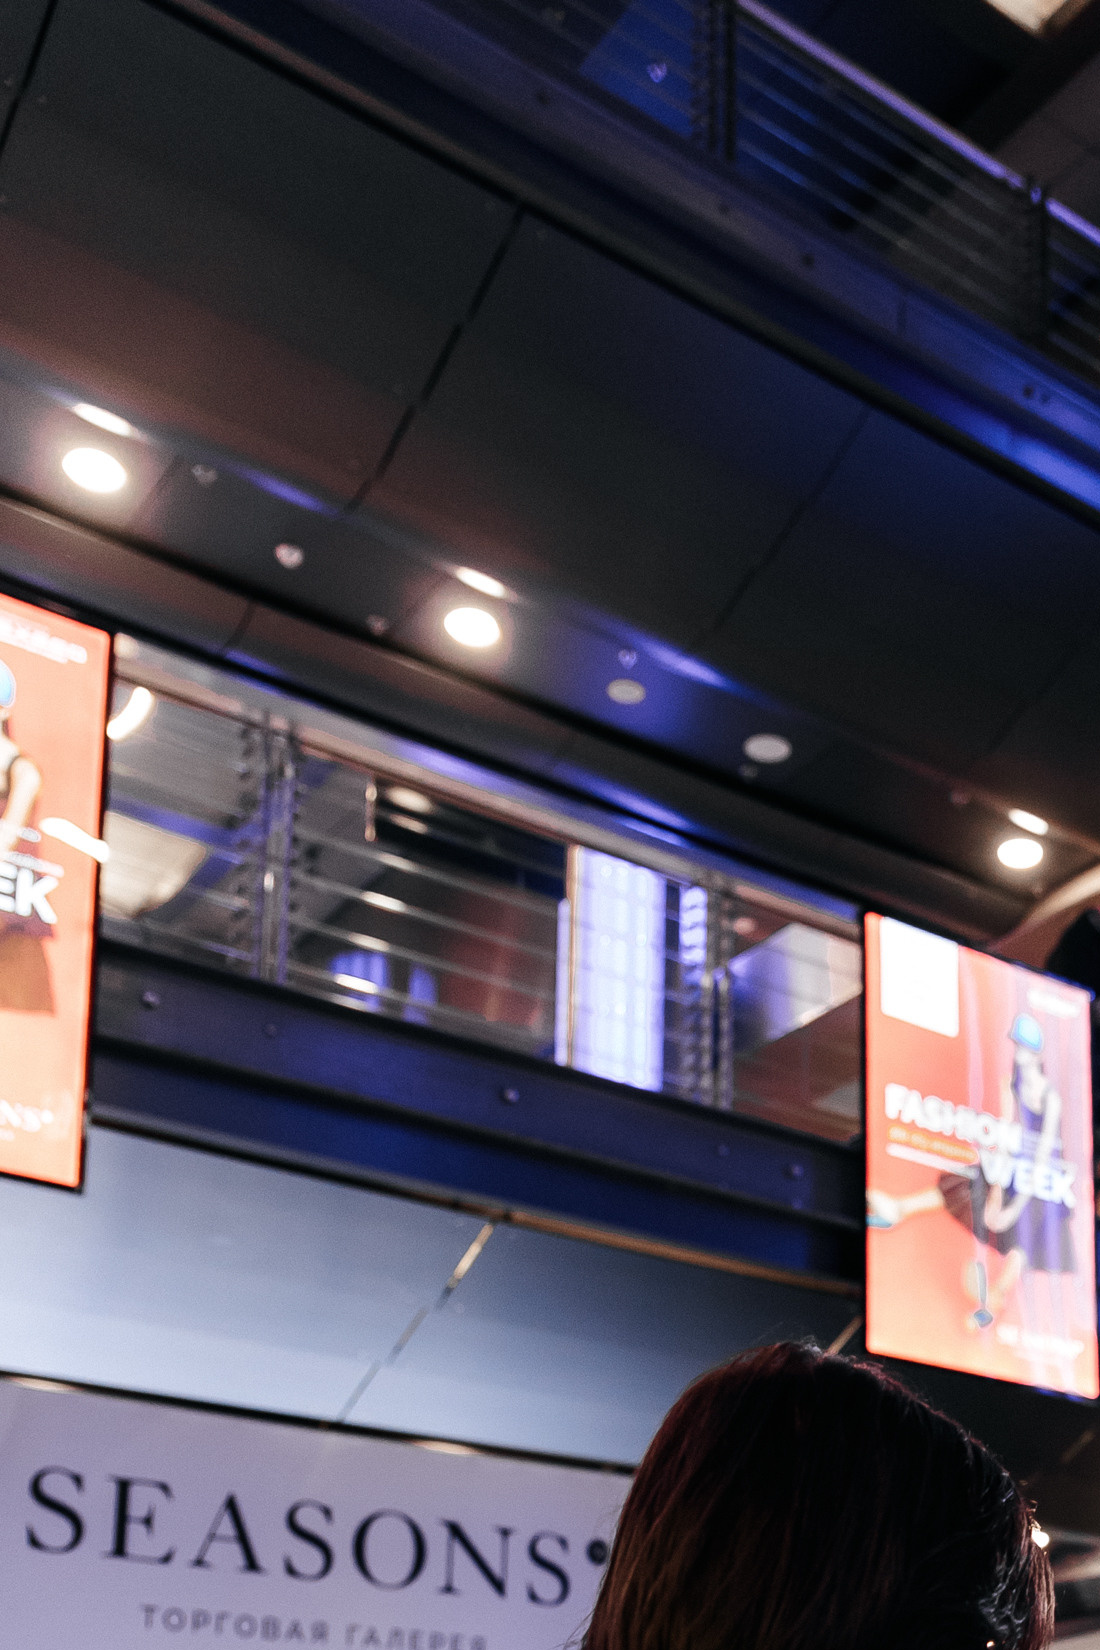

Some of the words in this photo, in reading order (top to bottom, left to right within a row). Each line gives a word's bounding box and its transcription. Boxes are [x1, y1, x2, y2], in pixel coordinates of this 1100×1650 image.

[885, 1082, 1022, 1152] FASHION
[978, 1149, 1077, 1209] WEEK
[25, 1464, 572, 1609] SEASONS
[139, 1603, 330, 1645] ТОРГОВАЯ
